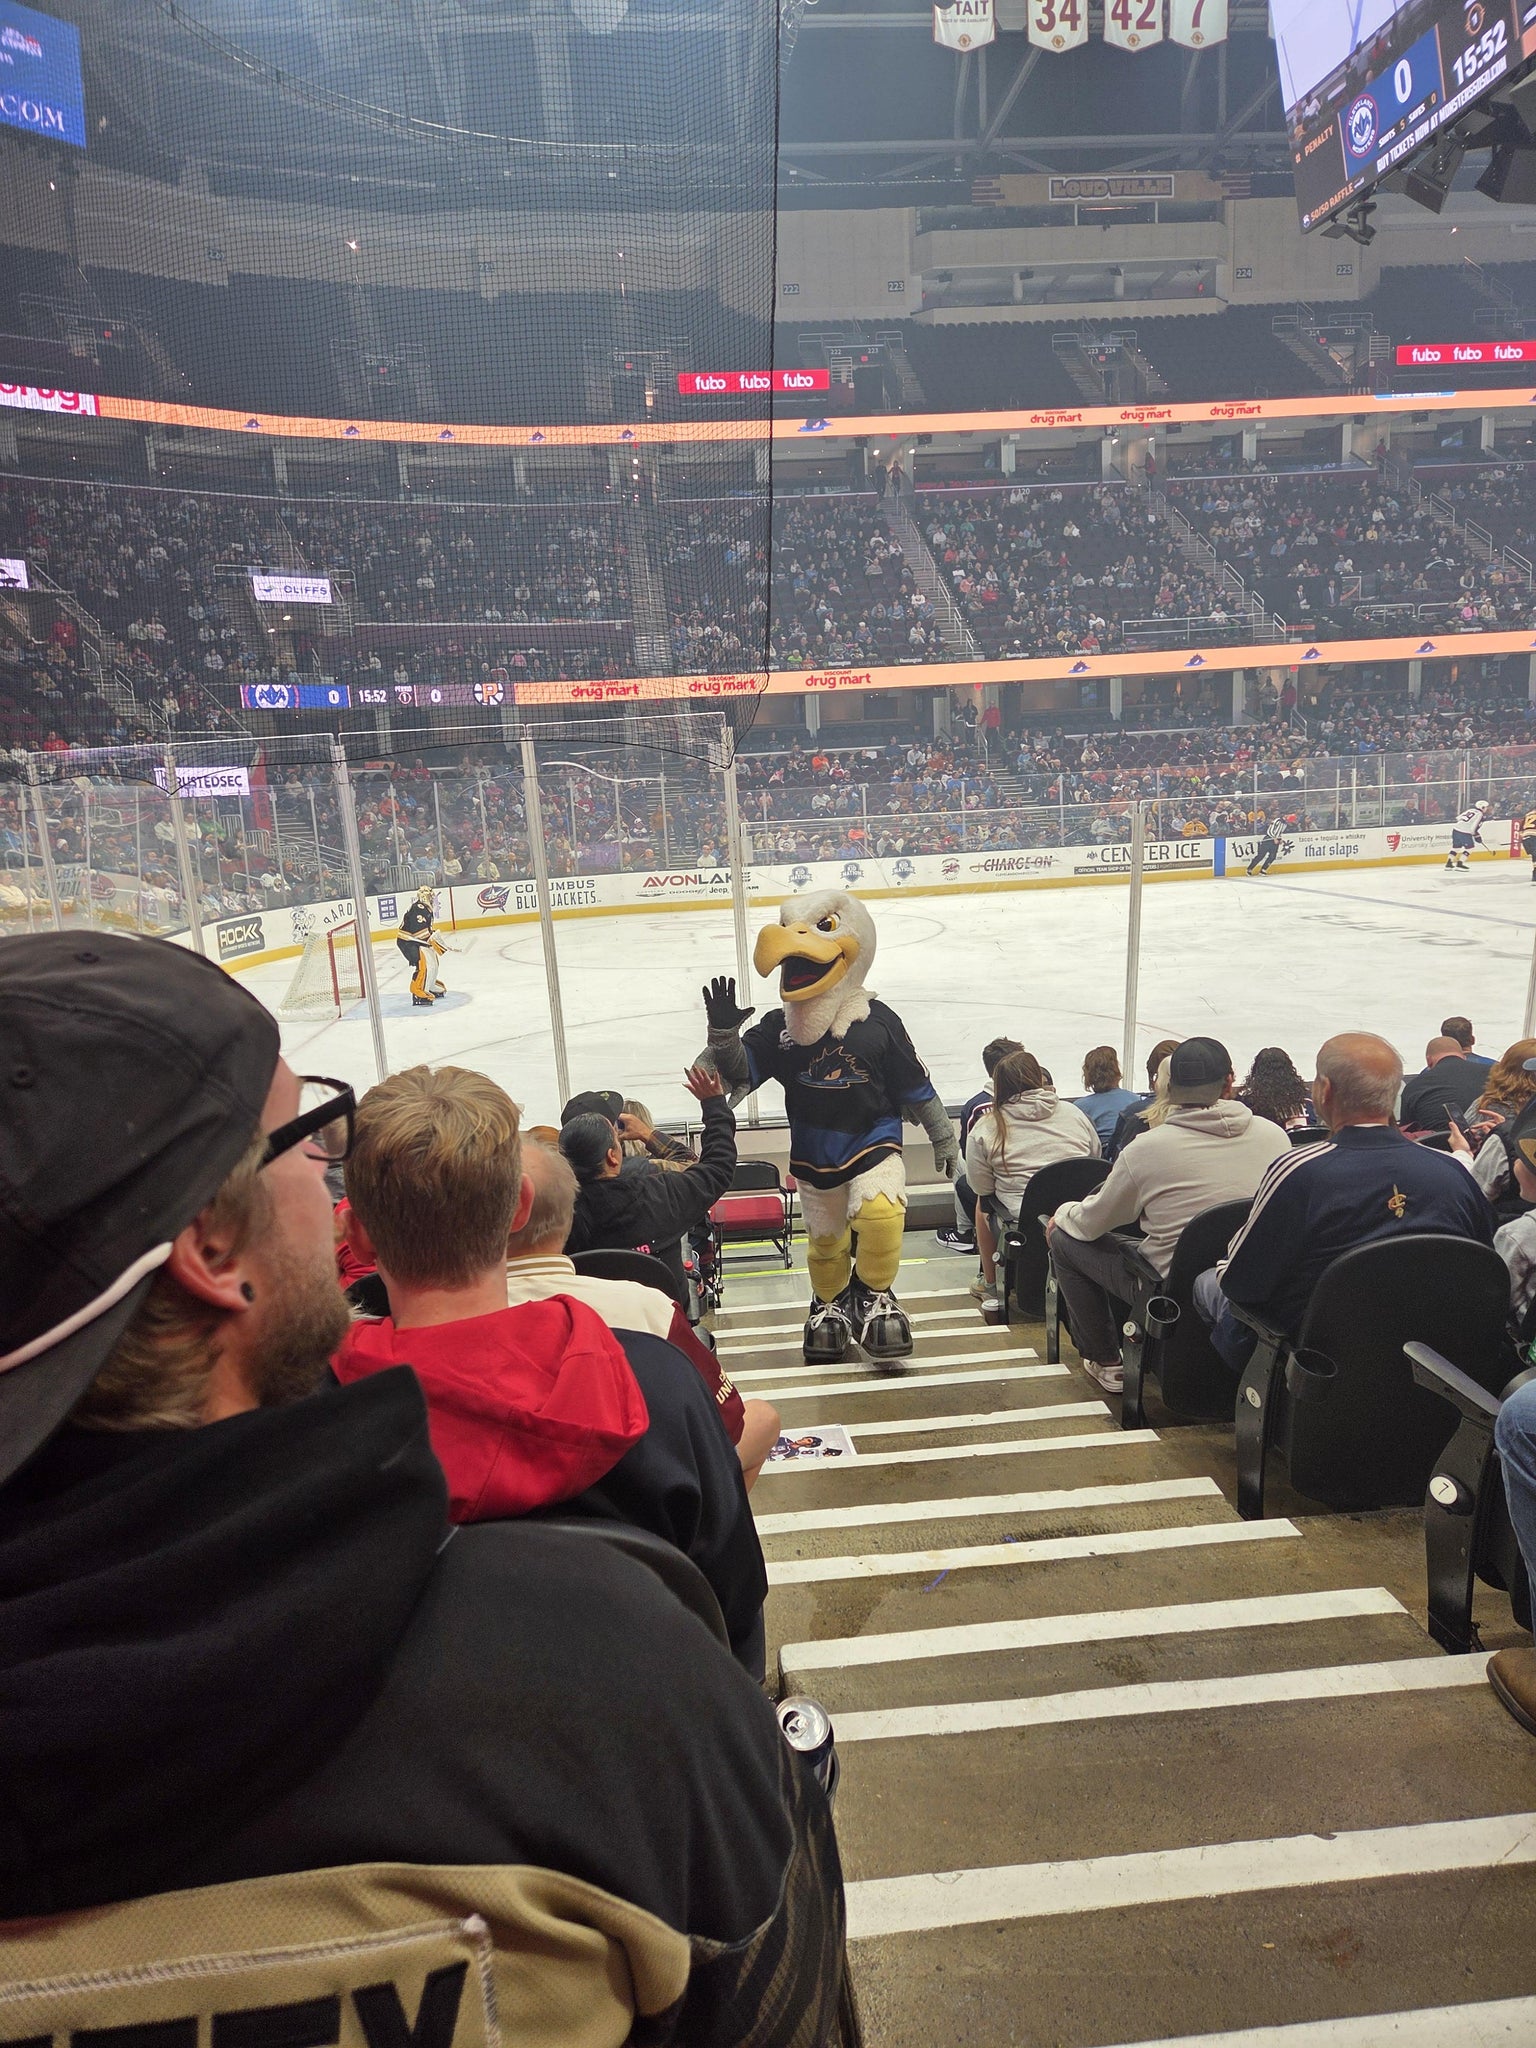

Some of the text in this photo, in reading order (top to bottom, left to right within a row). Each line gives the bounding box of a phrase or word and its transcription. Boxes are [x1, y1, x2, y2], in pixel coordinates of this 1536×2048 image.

[955, 0, 988, 15] TAIT
[1111, 0, 1156, 30] 42
[1035, 0, 1081, 32] 34
[1453, 19, 1508, 85] 15:52
[1394, 59, 1412, 103] 0
[1304, 125, 1333, 156] PENALTY
[1390, 132, 1415, 162] TICKETS
[1329, 183, 1354, 208] RAFFLE
[783, 285, 799, 294] 222
[888, 282, 904, 291] 223
[1412, 348, 1441, 362] fubo
[1453, 346, 1482, 361] fubo
[1494, 345, 1523, 360] fubo
[695, 375, 726, 390] fubo
[739, 374, 770, 389] fubo
[783, 373, 814, 388] fubo
[1030, 413, 1082, 425] drug mart
[1120, 409, 1172, 422] drug mart
[1210, 405, 1262, 418] drug mart
[284, 585, 327, 595] CLIFFS
[689, 677, 756, 694] drug mart
[805, 673, 871, 689] drug mart
[328, 690, 340, 704] 0
[359, 690, 387, 703] 15:52
[431, 689, 441, 703] 0
[571, 684, 639, 699] drug mart
[176, 775, 242, 788] RUSTEDSEC
[1401, 834, 1434, 842] University
[1176, 843, 1200, 859] ICE
[1305, 843, 1359, 857] that slaps
[515, 880, 595, 893] COUMBUS
[516, 891, 596, 909] BLU JACKETS
